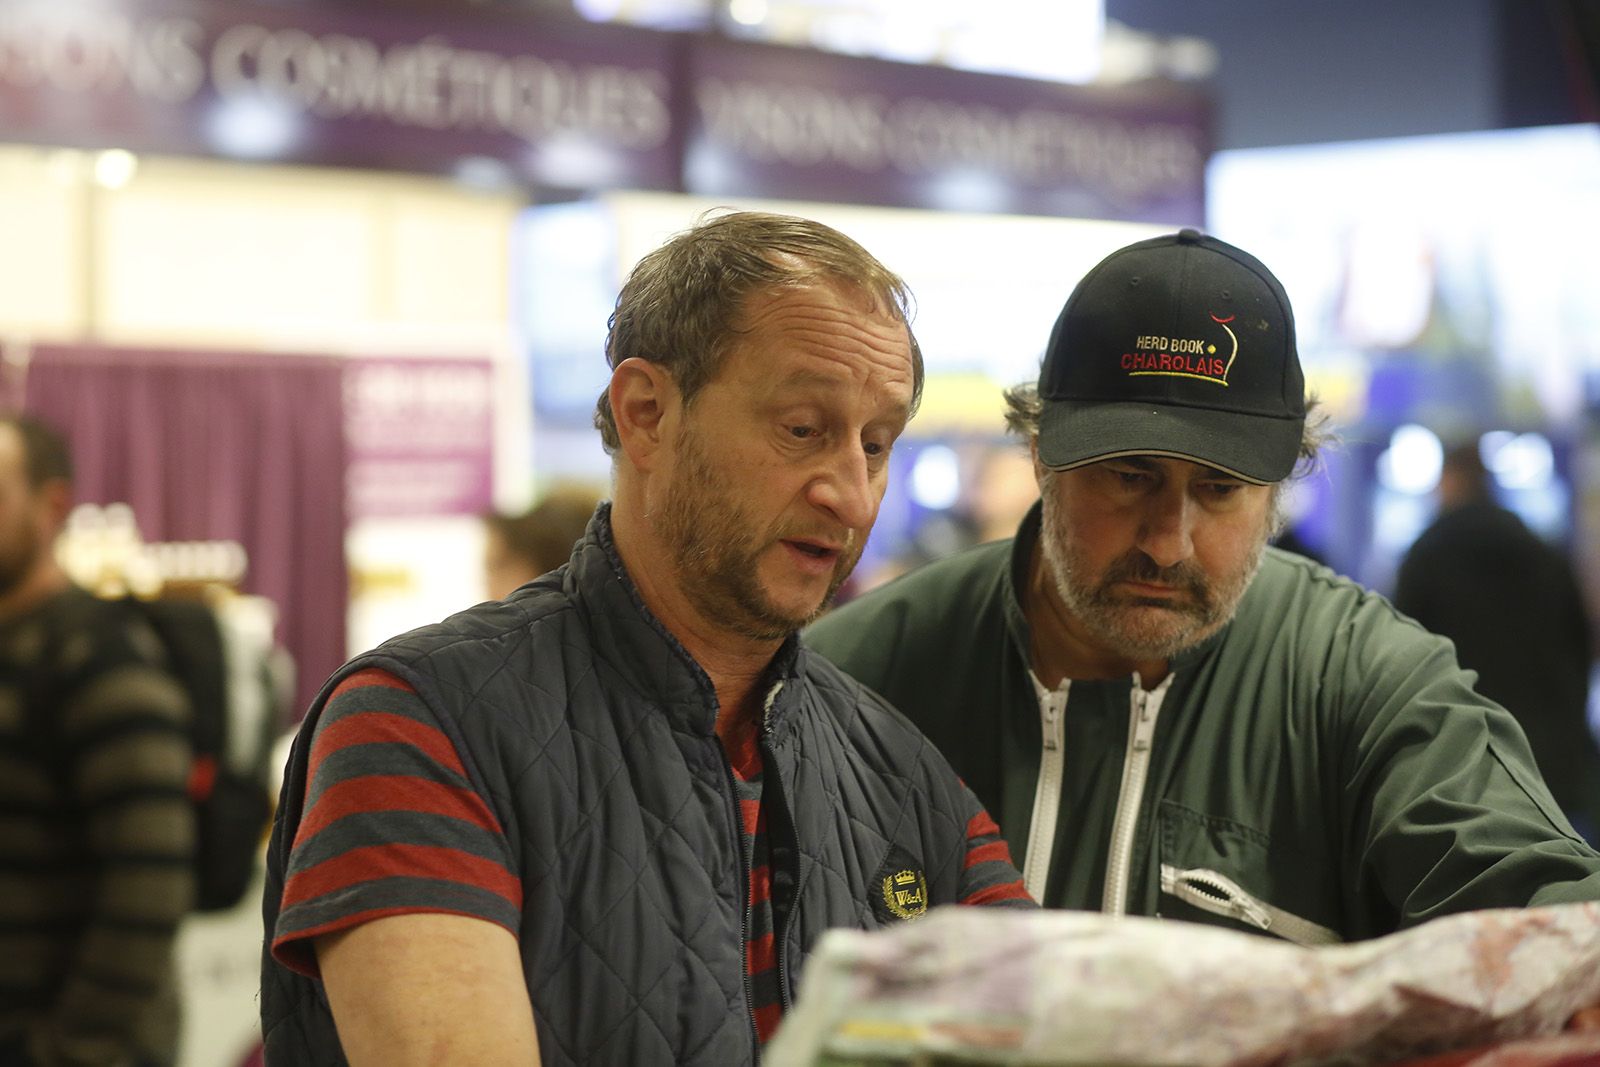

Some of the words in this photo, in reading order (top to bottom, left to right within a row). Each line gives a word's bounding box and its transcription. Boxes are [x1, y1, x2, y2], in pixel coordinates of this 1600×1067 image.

[211, 25, 671, 151] COSMÉTIQUES
[1136, 336, 1168, 350] HERD
[1171, 338, 1205, 354] BOOK
[1121, 353, 1224, 375] CHAROLAIS
[895, 888, 922, 906] W&A
